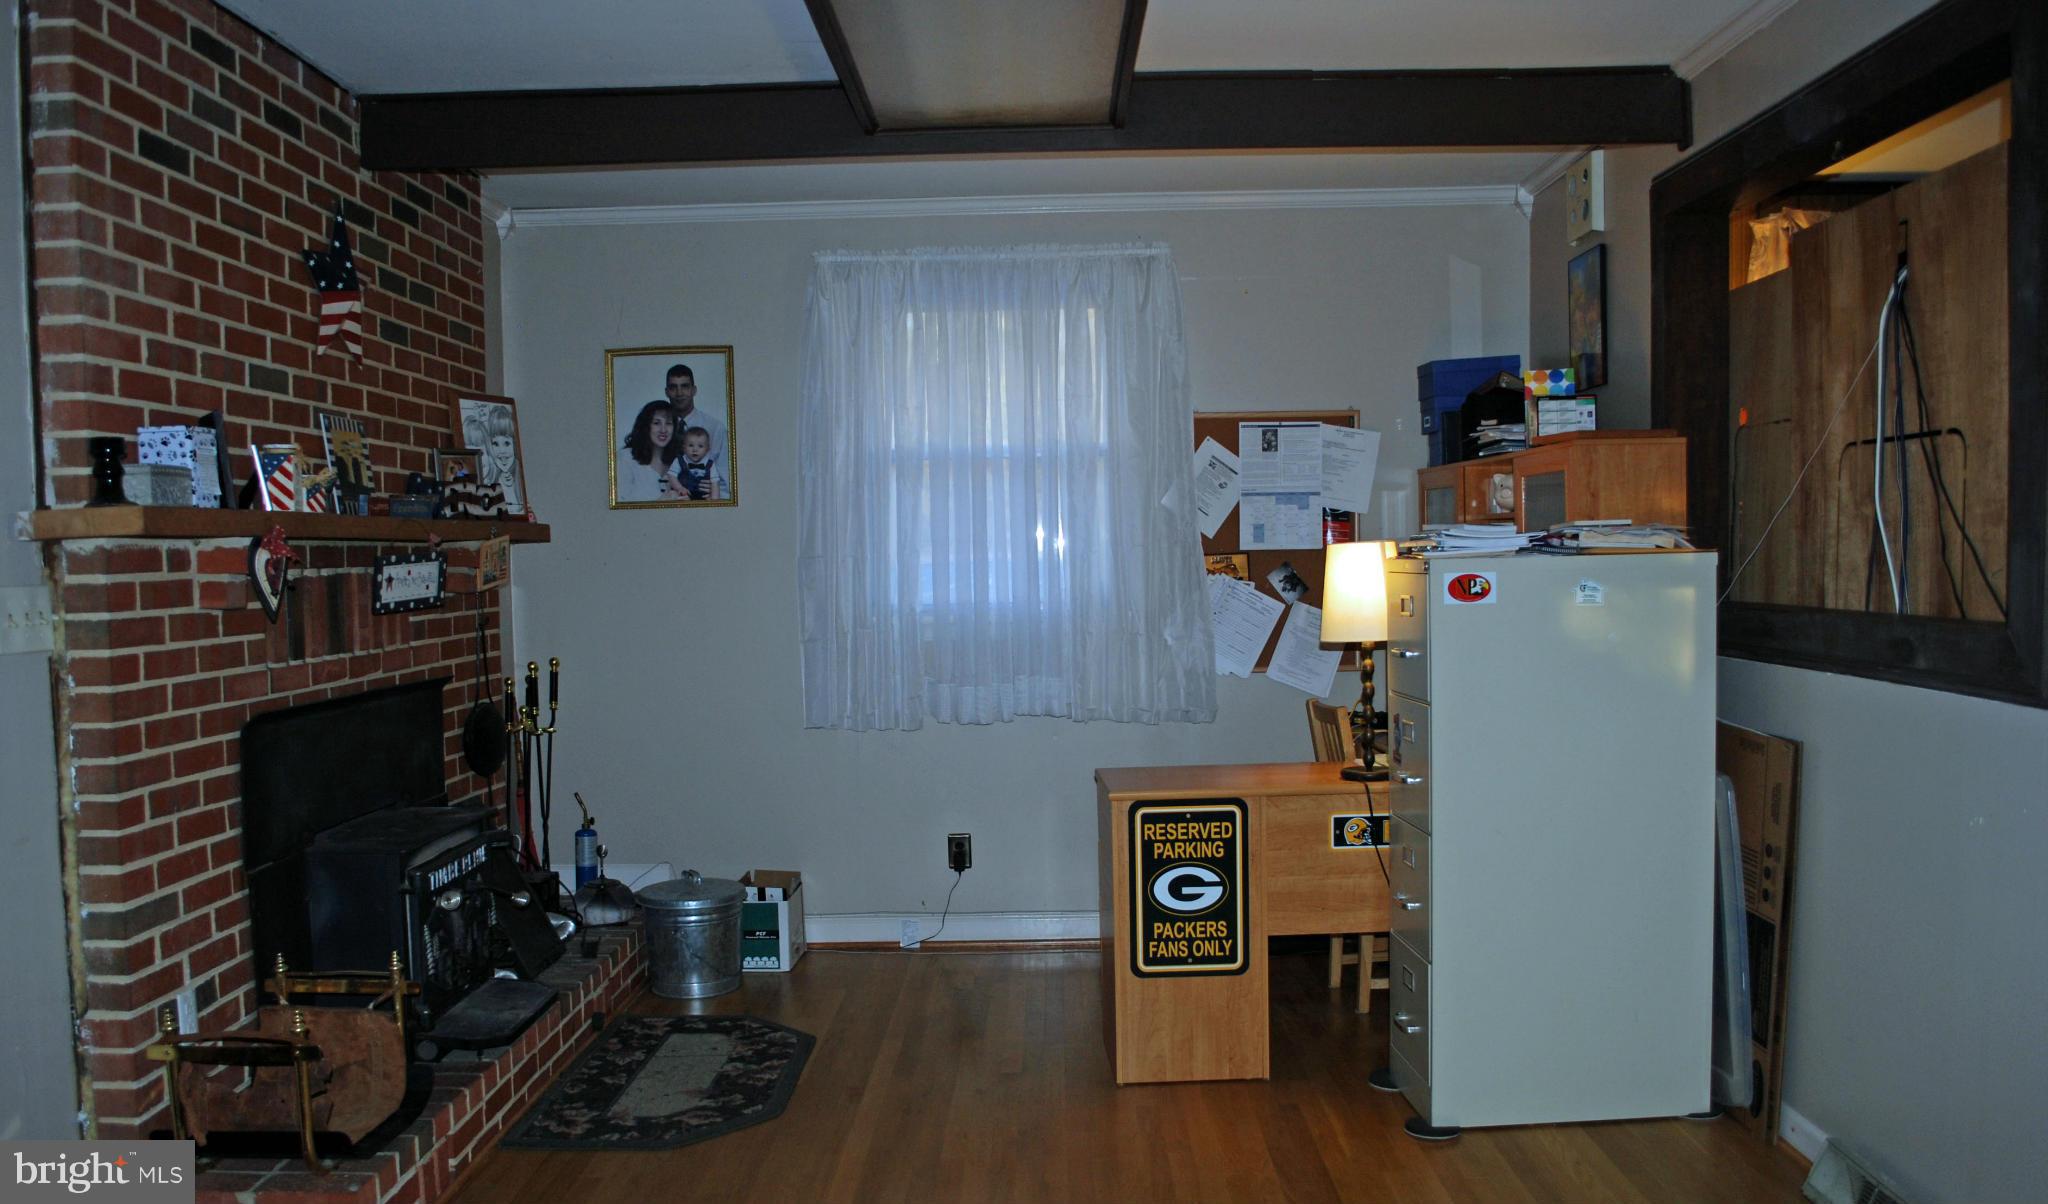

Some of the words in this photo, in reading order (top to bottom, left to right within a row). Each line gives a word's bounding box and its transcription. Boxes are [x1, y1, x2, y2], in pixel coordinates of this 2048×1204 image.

[1144, 822, 1232, 840] RESERVED
[1154, 841, 1224, 859] PARKING
[1154, 866, 1223, 911] G
[1153, 921, 1228, 939] PACKERS
[1149, 941, 1188, 958] FANS
[1192, 940, 1232, 957] ONLY
